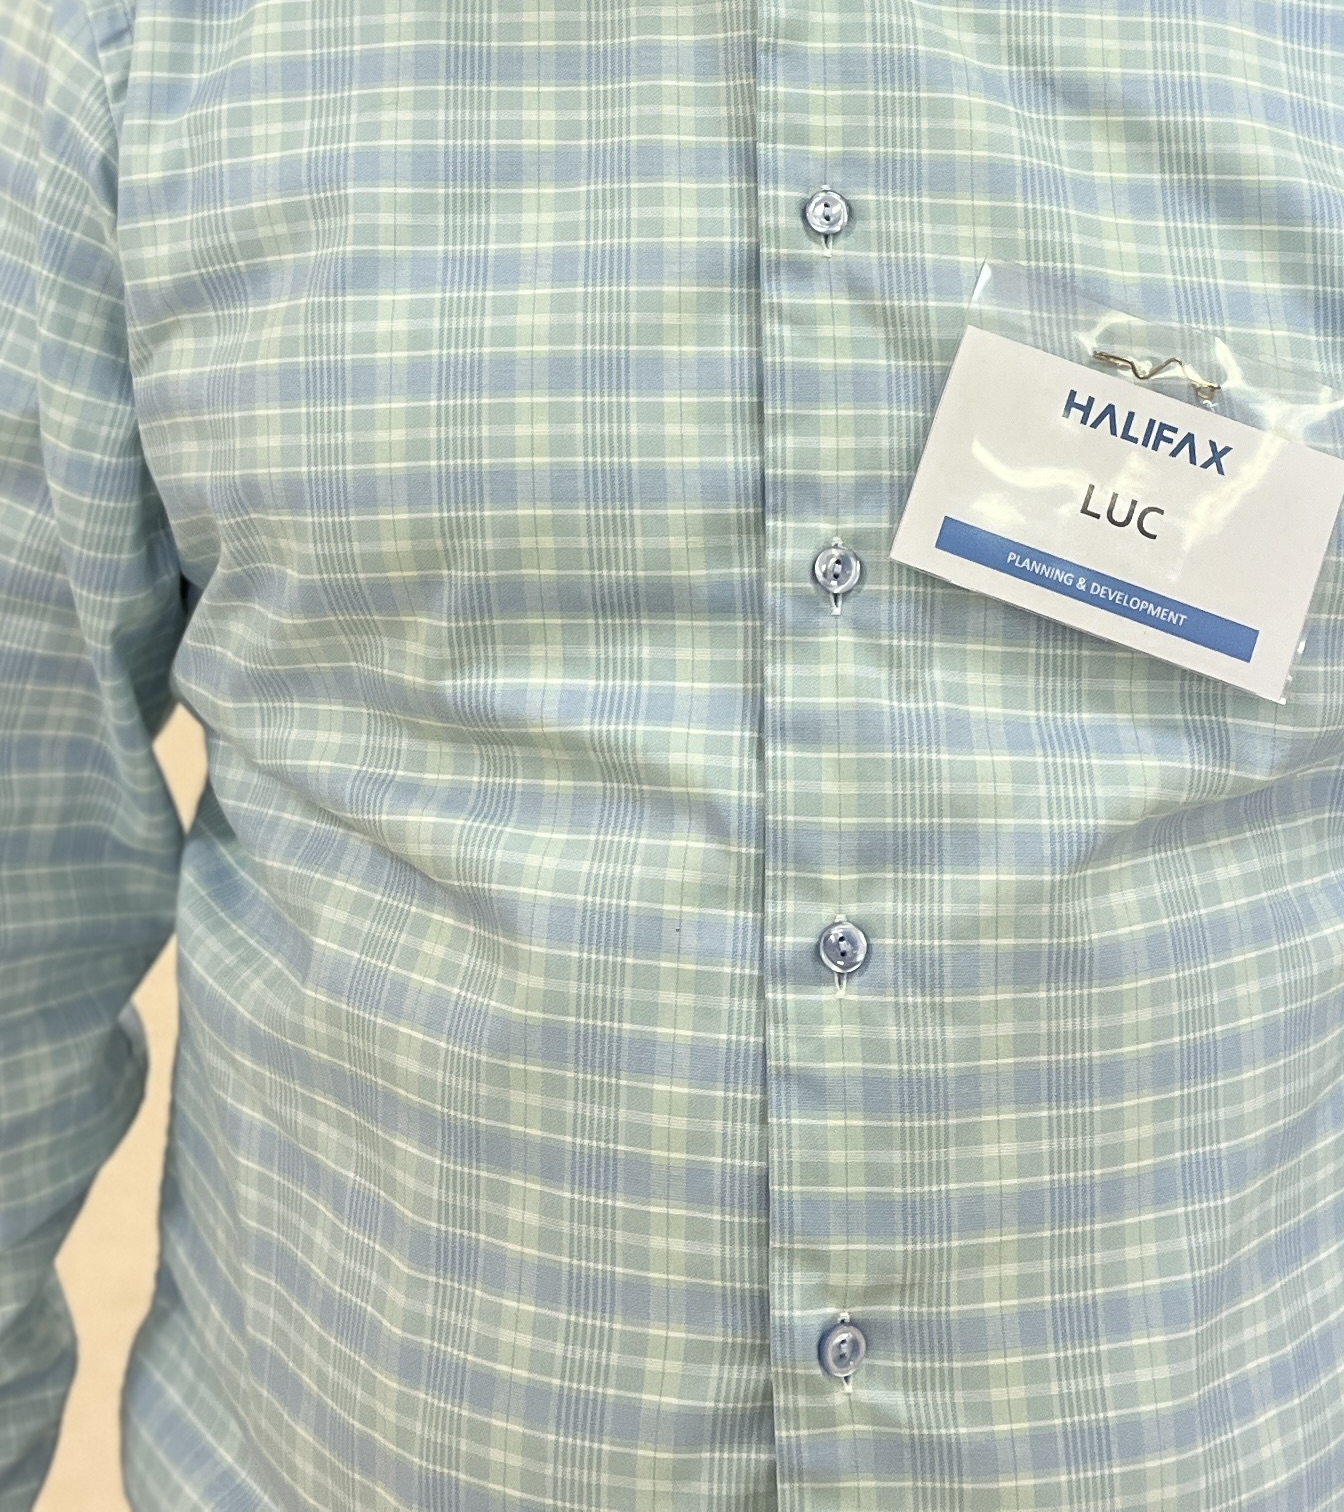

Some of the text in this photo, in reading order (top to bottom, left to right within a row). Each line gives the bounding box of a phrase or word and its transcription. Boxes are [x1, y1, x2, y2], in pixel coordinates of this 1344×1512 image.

[1062, 389, 1233, 475] HALIFAX
[1080, 484, 1165, 540] LUC
[1006, 551, 1188, 627] PLANNING & DEVELOPMENT
